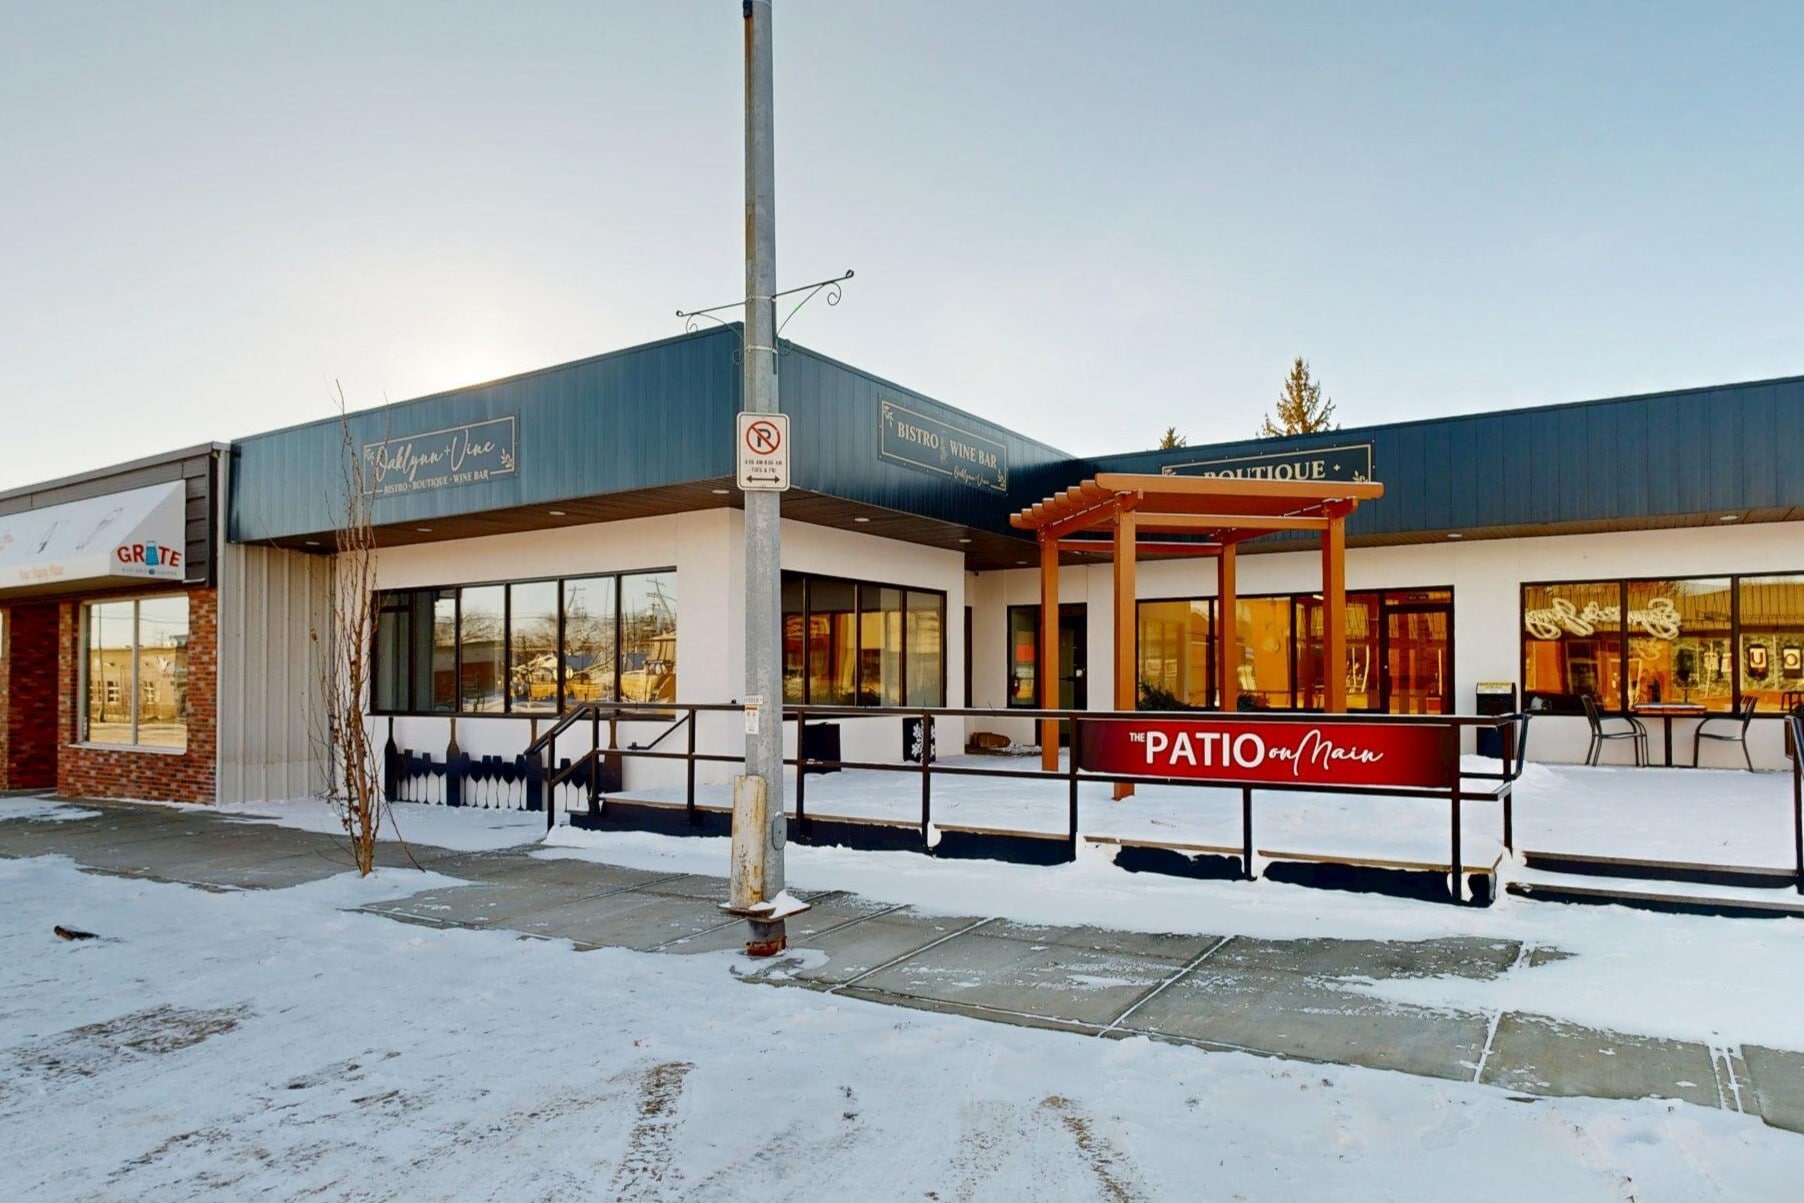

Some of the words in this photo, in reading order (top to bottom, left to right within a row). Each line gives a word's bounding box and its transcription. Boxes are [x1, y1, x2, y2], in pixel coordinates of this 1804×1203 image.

[450, 429, 496, 471] Vine
[897, 422, 939, 449] BISTRO
[949, 439, 977, 462] WINE
[978, 450, 998, 470] BAR
[383, 482, 408, 495] BISTRO
[412, 475, 449, 490] BOUTIQUE
[453, 472, 473, 484] WINE
[473, 469, 489, 481] BAR
[1129, 731, 1145, 743] THE
[1145, 731, 1266, 768] PATIO
[1268, 747, 1296, 761] on
[1293, 729, 1384, 776] Main
